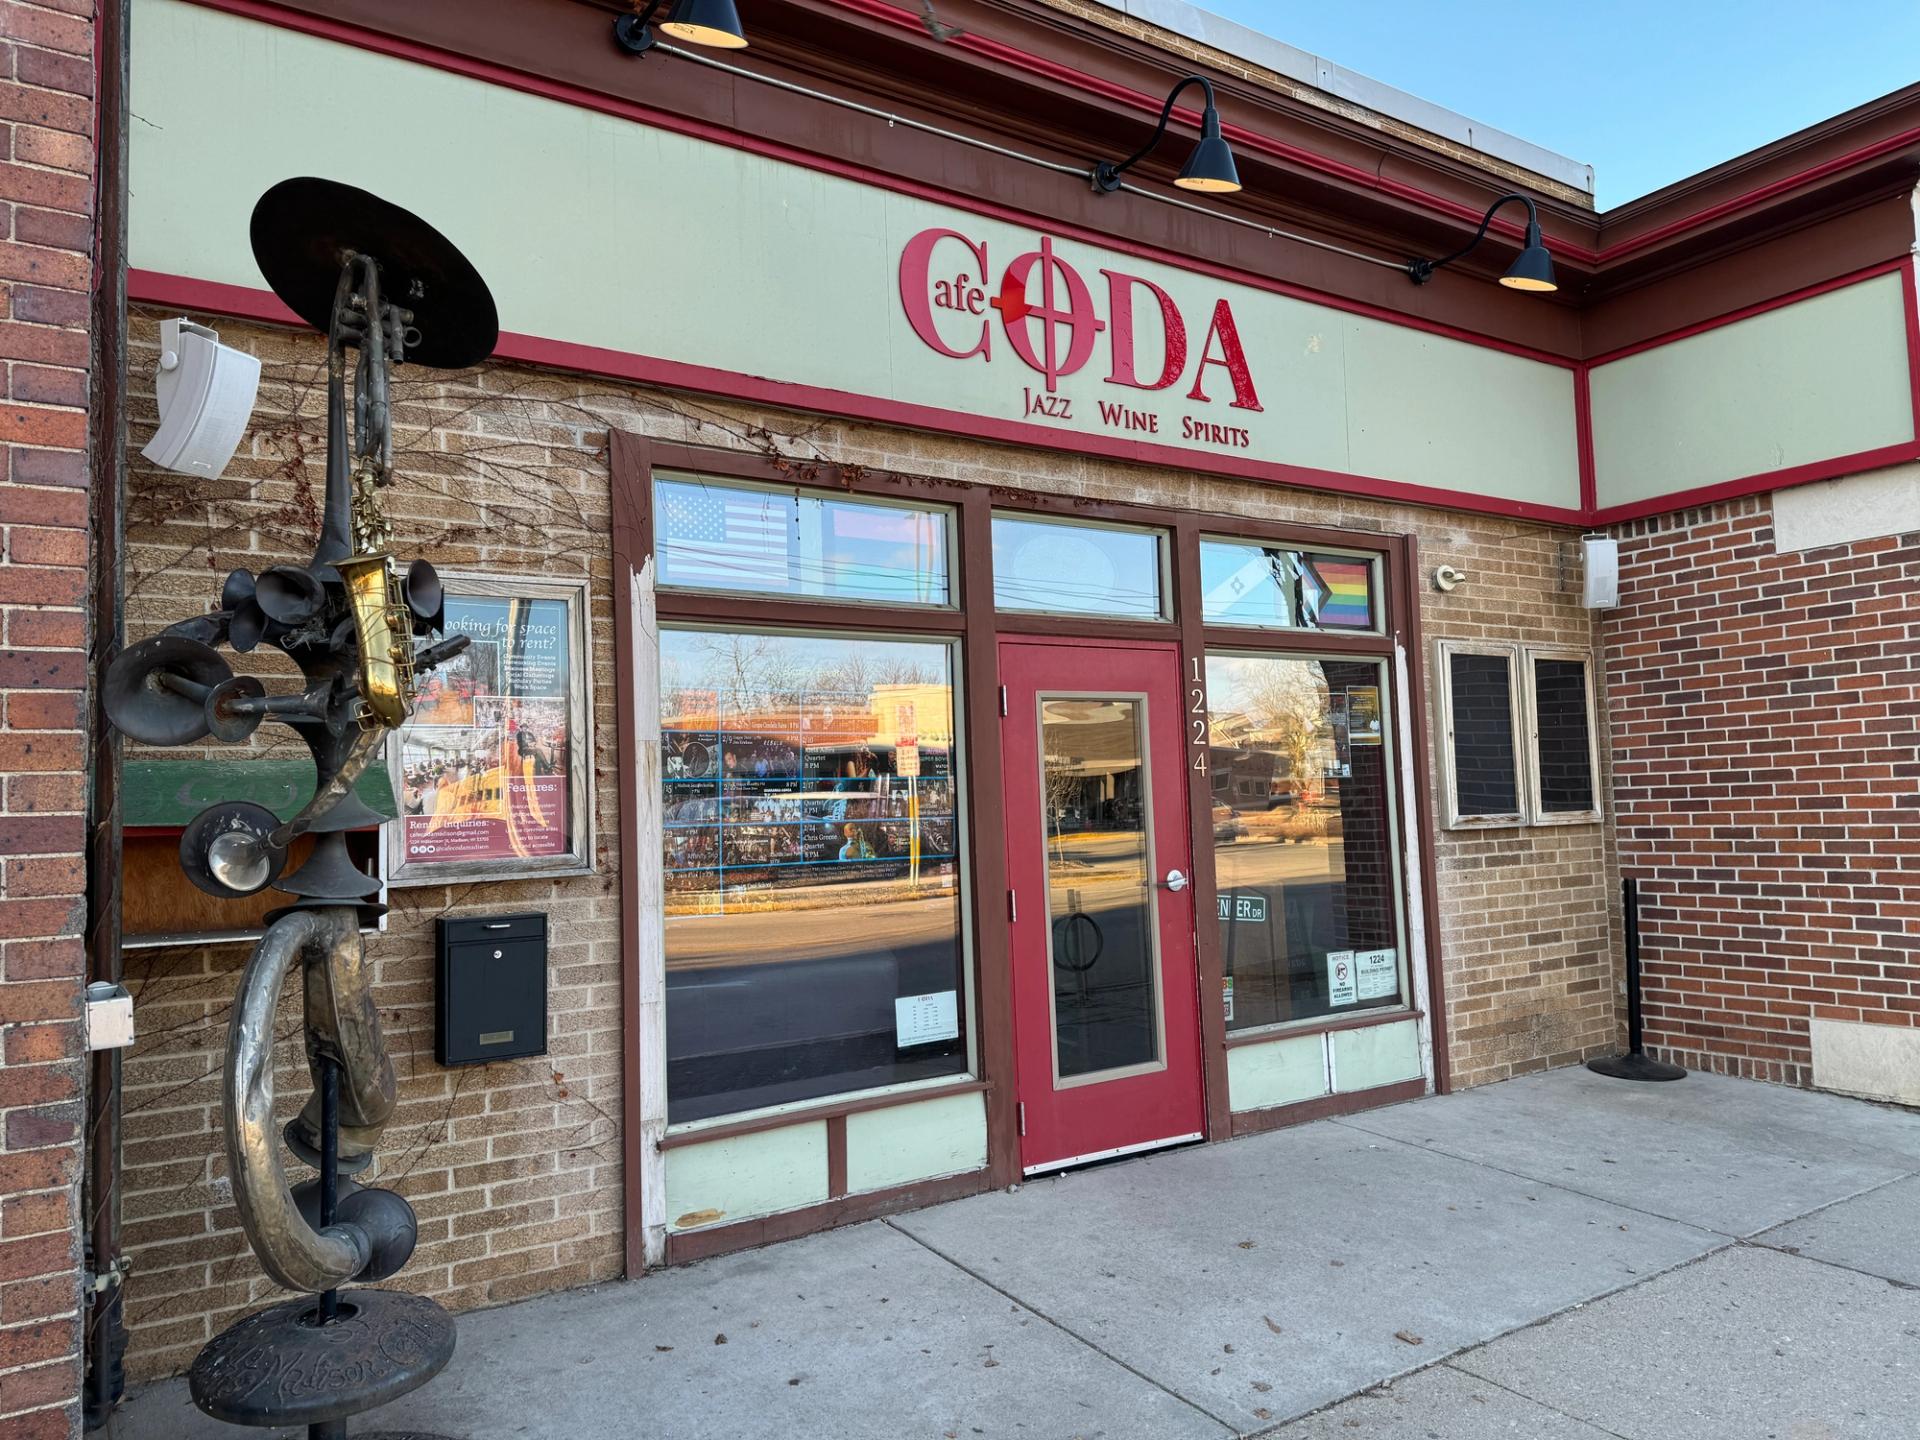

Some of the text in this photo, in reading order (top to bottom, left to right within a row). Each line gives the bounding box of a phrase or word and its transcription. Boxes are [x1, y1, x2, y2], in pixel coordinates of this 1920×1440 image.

[445, 614, 491, 637] ooking
[519, 623, 557, 637] space
[502, 637, 557, 649] to rent?
[1252, 908, 1262, 918] DR
[1369, 954, 1385, 964] 1224
